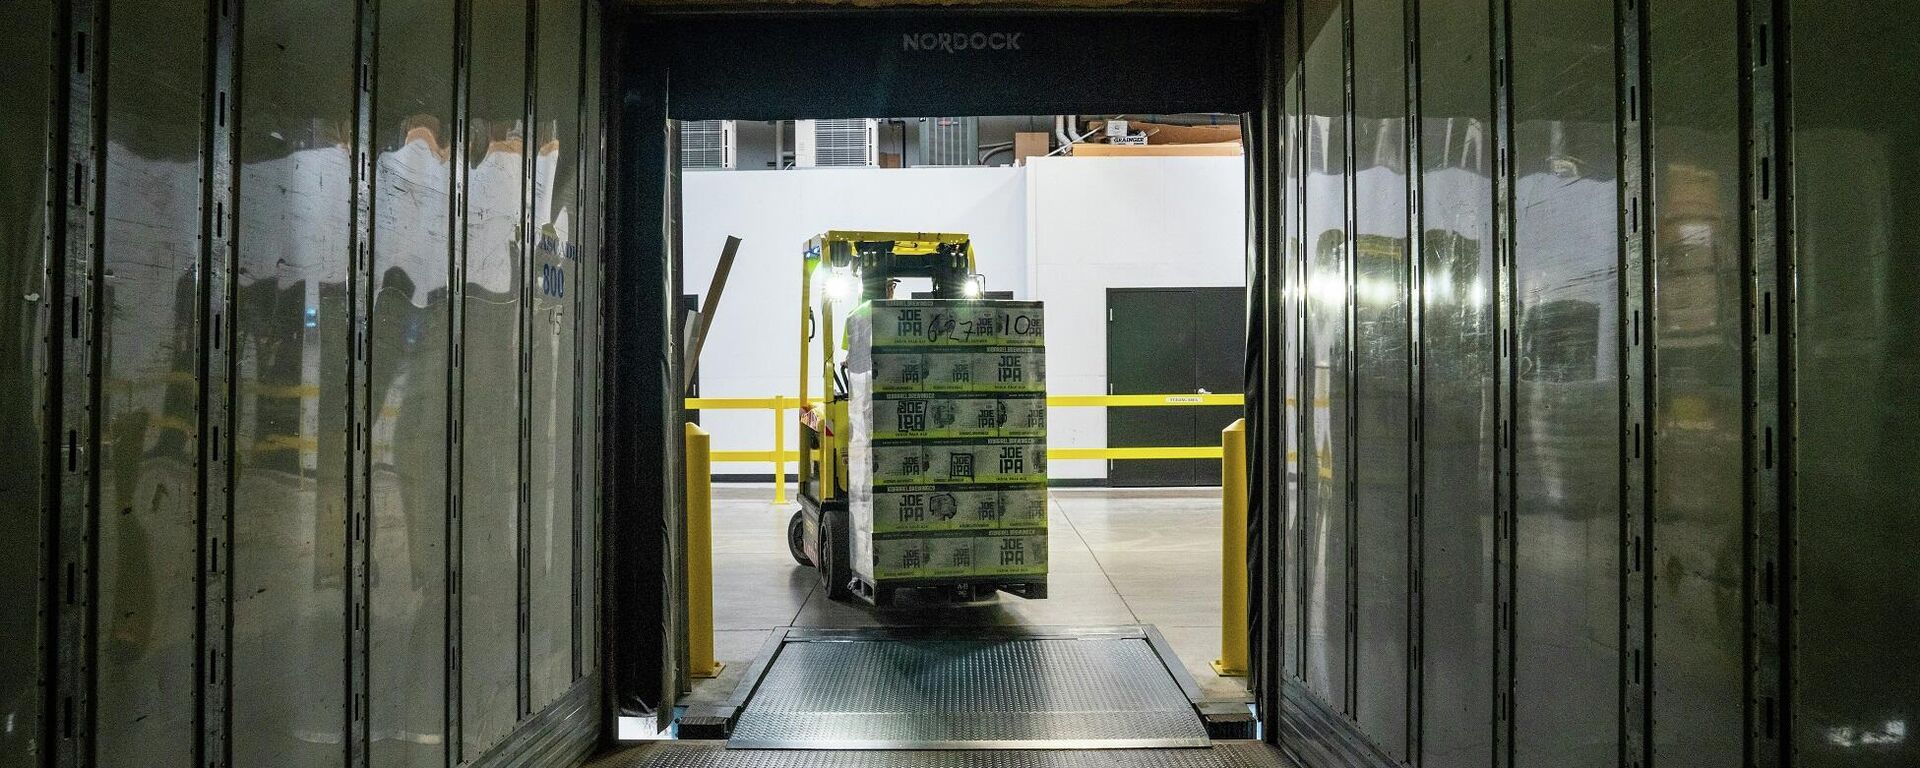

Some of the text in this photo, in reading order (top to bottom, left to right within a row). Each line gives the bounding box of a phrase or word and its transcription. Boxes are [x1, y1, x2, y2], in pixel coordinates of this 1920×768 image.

[903, 32, 1021, 53] NORDOCK
[543, 264, 565, 298] 800
[898, 310, 921, 320] JOE
[977, 318, 992, 326] JOE
[898, 323, 922, 336] IPA
[977, 327, 993, 335] IPA
[998, 356, 1021, 366] JOE
[903, 364, 919, 372] JOE
[953, 364, 969, 372] JOE
[902, 374, 919, 383] IPA
[952, 373, 969, 382] IPA
[998, 368, 1021, 382] IPA
[899, 401, 922, 413] JOE
[899, 415, 924, 431] IPA
[978, 419, 995, 428] IPA
[1027, 419, 1044, 427] IPA
[1000, 447, 1022, 458] JOE
[903, 457, 919, 465] JOE
[954, 456, 969, 464] JOE
[903, 466, 919, 475] IPA
[953, 466, 970, 475] IPA
[1000, 459, 1022, 473] IPA
[900, 495, 923, 506] JOE
[978, 502, 994, 510] JOE
[900, 508, 924, 521] IPA
[978, 511, 994, 520] IPA
[1001, 539, 1023, 550] JOE
[904, 549, 919, 557] JOE
[954, 549, 969, 557] JOE
[954, 558, 969, 567] IPA
[1001, 551, 1023, 565] IPA
[903, 559, 920, 568] IPA
